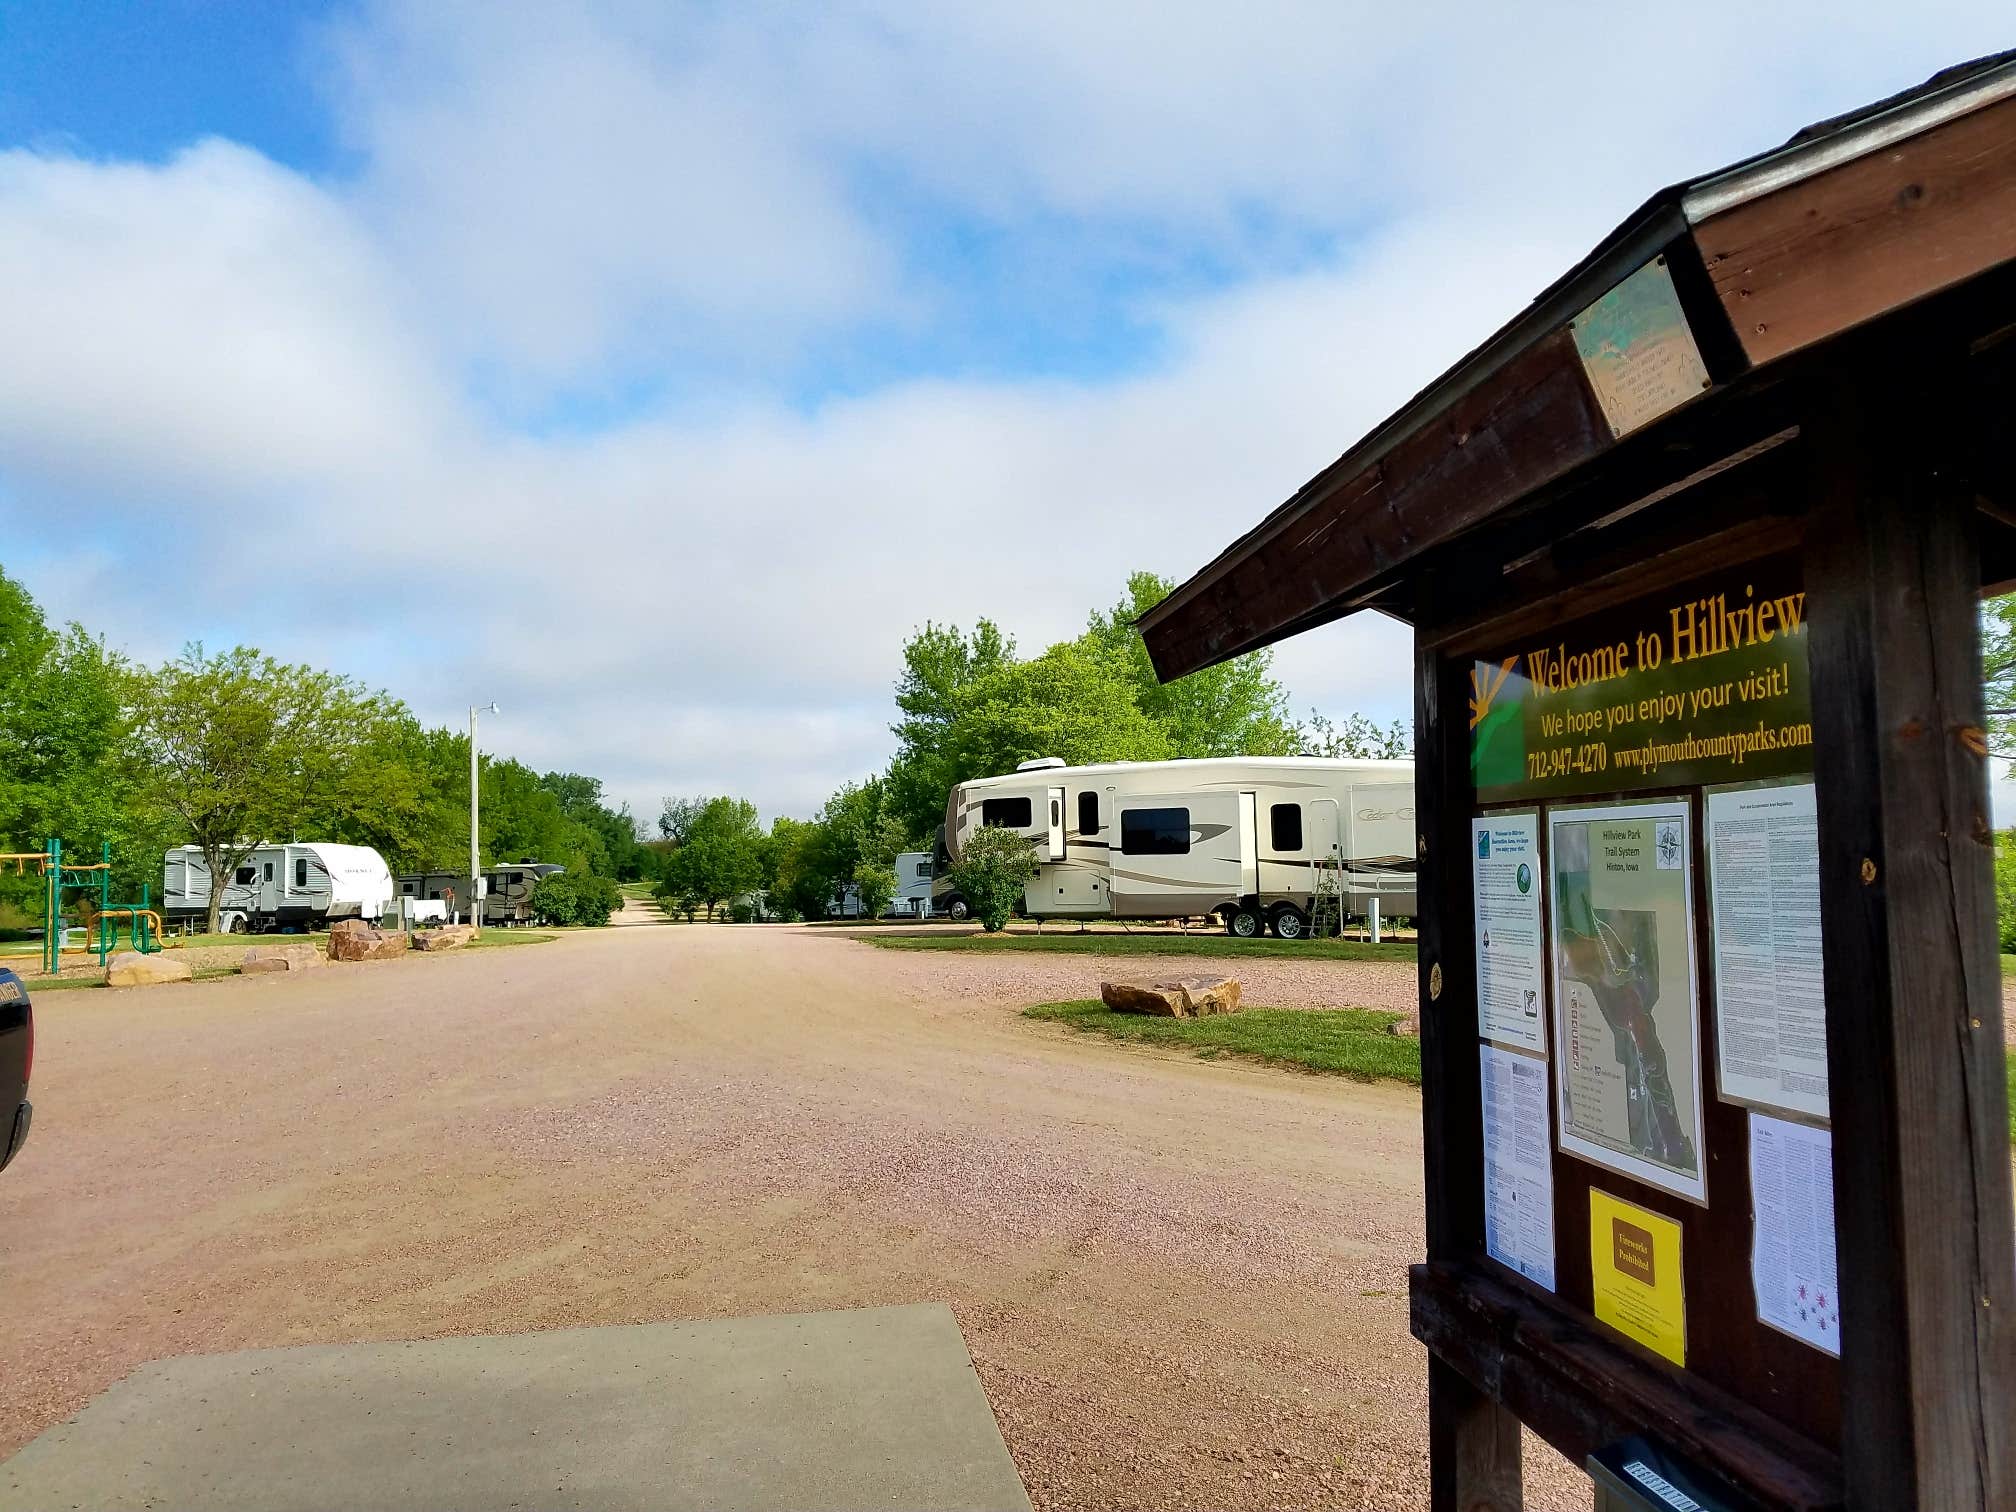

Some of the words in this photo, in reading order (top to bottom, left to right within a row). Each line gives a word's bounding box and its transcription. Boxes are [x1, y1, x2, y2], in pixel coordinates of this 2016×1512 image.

[1528, 642, 1629, 698] Welcome
[1636, 631, 1662, 670] to
[1670, 584, 1806, 664] Hillview
[1541, 713, 1564, 738] We
[1567, 707, 1602, 736] hope
[1606, 703, 1635, 733] you
[1639, 690, 1685, 724] enjoy
[1691, 681, 1734, 718] your
[1738, 662, 1790, 702] visit!
[1528, 741, 1607, 781] 712-947-4270
[1614, 720, 1813, 775] www.plymouthcountyparks.com
[1603, 830, 1627, 840] Hillview
[1628, 829, 1641, 840] Park
[1605, 847, 1618, 857] Trail
[1619, 847, 1640, 859] System
[1626, 863, 1639, 872] Iowa
[1619, 1233, 1648, 1254] Fireworks
[1619, 1248, 1649, 1271] Prohibited
